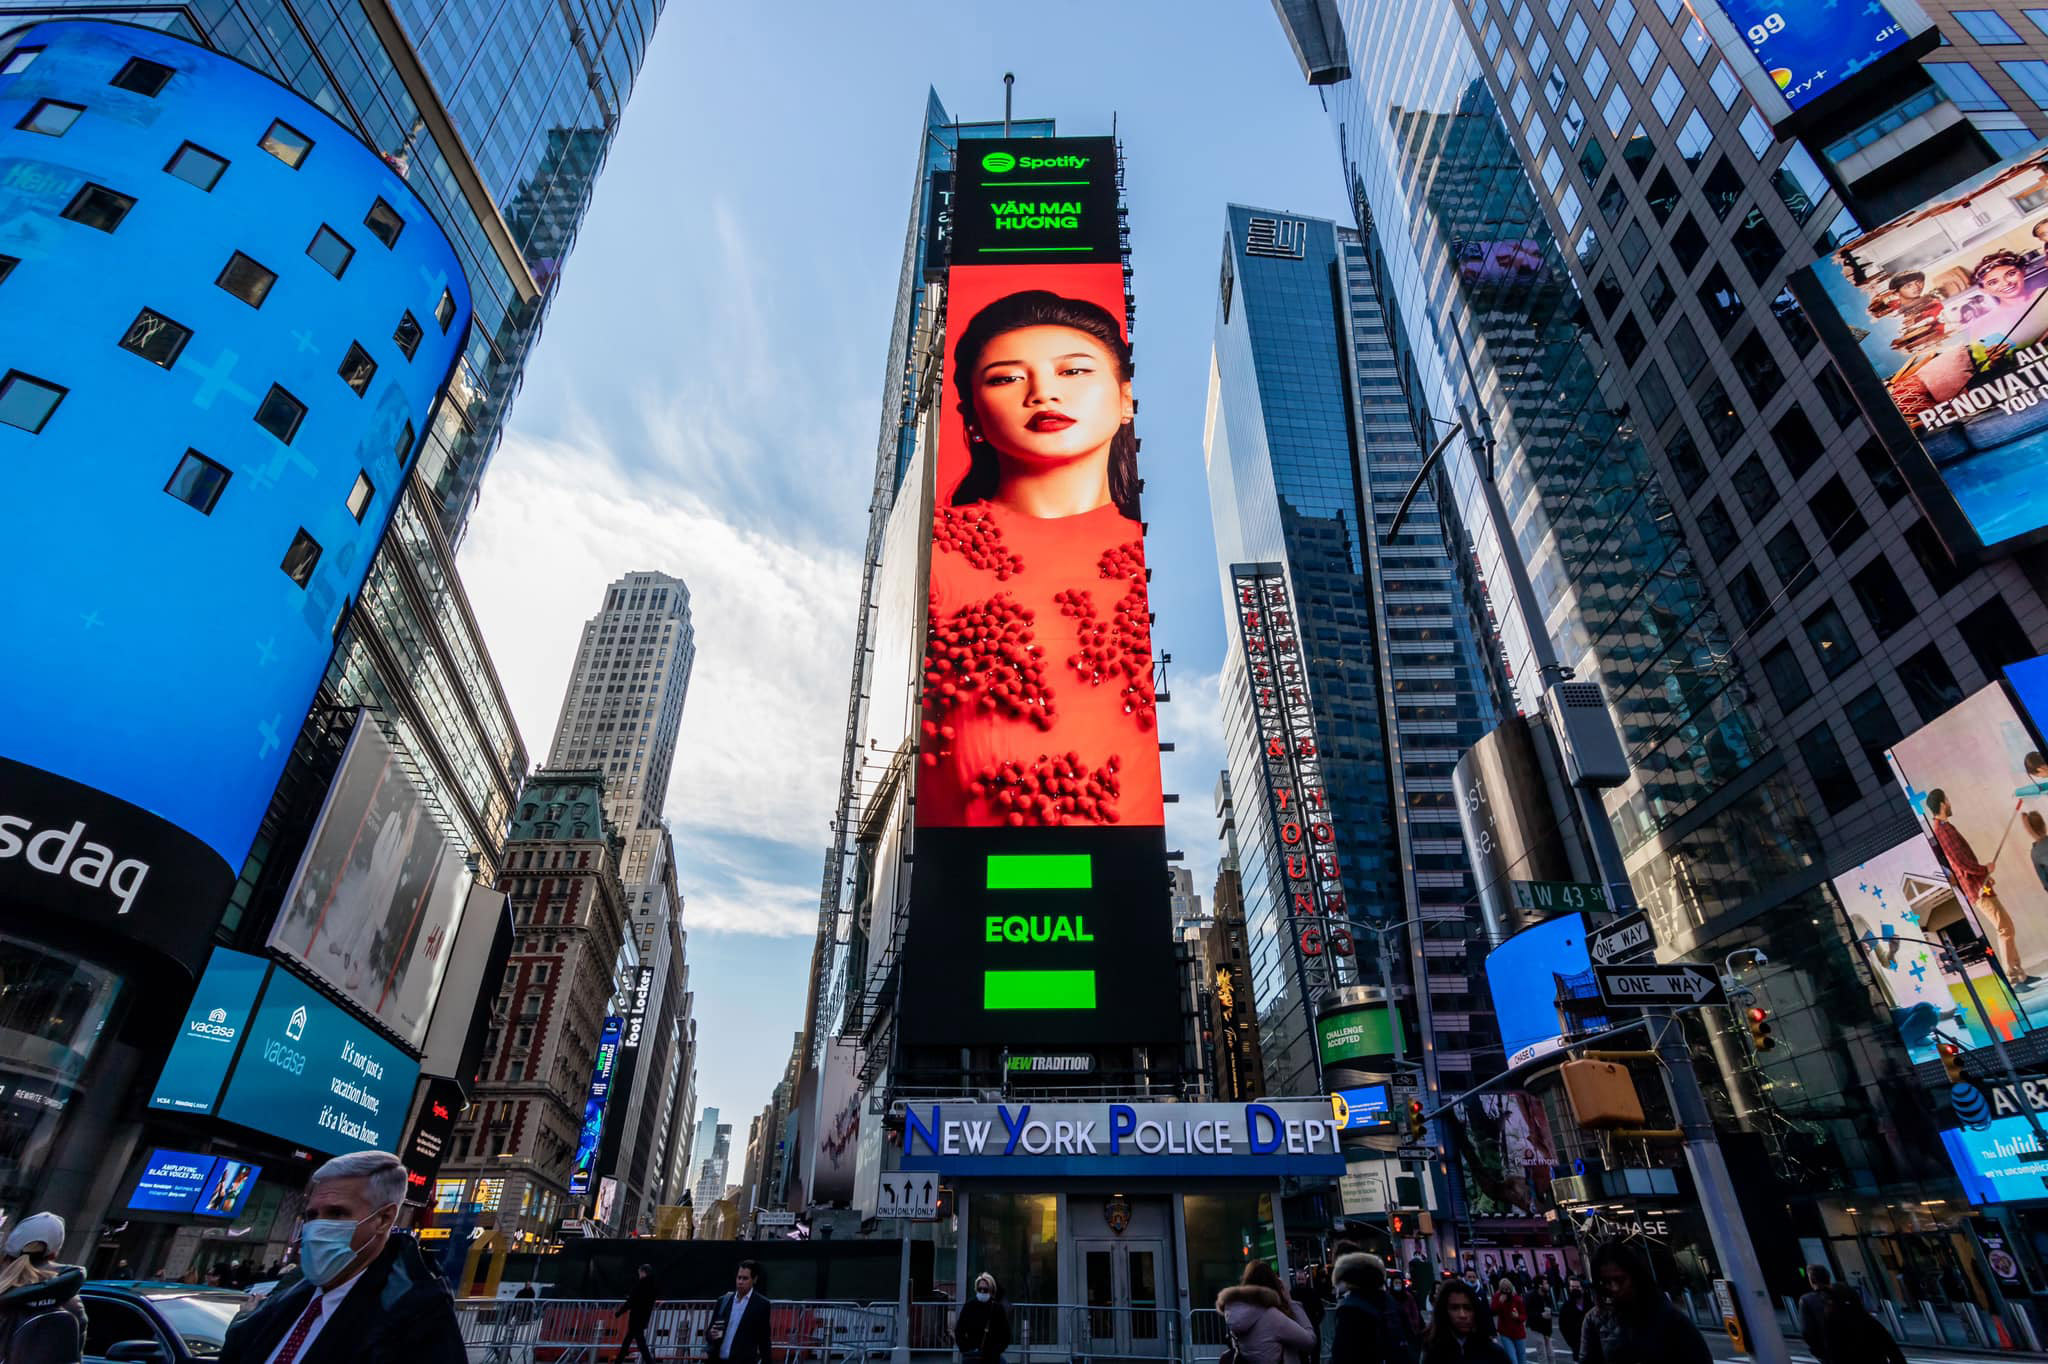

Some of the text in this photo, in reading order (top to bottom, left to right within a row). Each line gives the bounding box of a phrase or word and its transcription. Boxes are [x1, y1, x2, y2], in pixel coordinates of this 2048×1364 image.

[1019, 155, 1086, 169] Spotify
[991, 200, 1081, 215] VĂN MAI
[995, 215, 1078, 230] HƯƠNG
[1917, 358, 2048, 432] RENOVATI
[1997, 390, 2039, 416] YOU
[0, 815, 150, 914] sdaq
[1276, 787, 1322, 955] YOUNG
[1534, 885, 1552, 906] W
[1563, 886, 1585, 908] 43
[985, 915, 1094, 943] EQUAL
[1596, 922, 1645, 958] ONE WAY
[632, 969, 652, 1014] Locker
[1617, 977, 1704, 993] ONE WAY
[191, 1020, 235, 1038] vacasa
[625, 1017, 643, 1047] Foot
[1326, 1025, 1364, 1040] CHALLENGE
[1327, 1034, 1360, 1049] ACCEPTED
[263, 1037, 306, 1076] vacasa
[353, 1050, 367, 1070] not
[363, 1056, 380, 1078] just
[377, 1067, 383, 1080] a
[331, 1076, 379, 1116] vacation home,
[331, 1114, 338, 1130] a
[339, 1112, 360, 1139] Vacasa
[359, 1121, 379, 1146] home.
[1993, 1133, 2044, 1158] holid
[878, 1207, 935, 1216] ONLY ONLY ONLY
